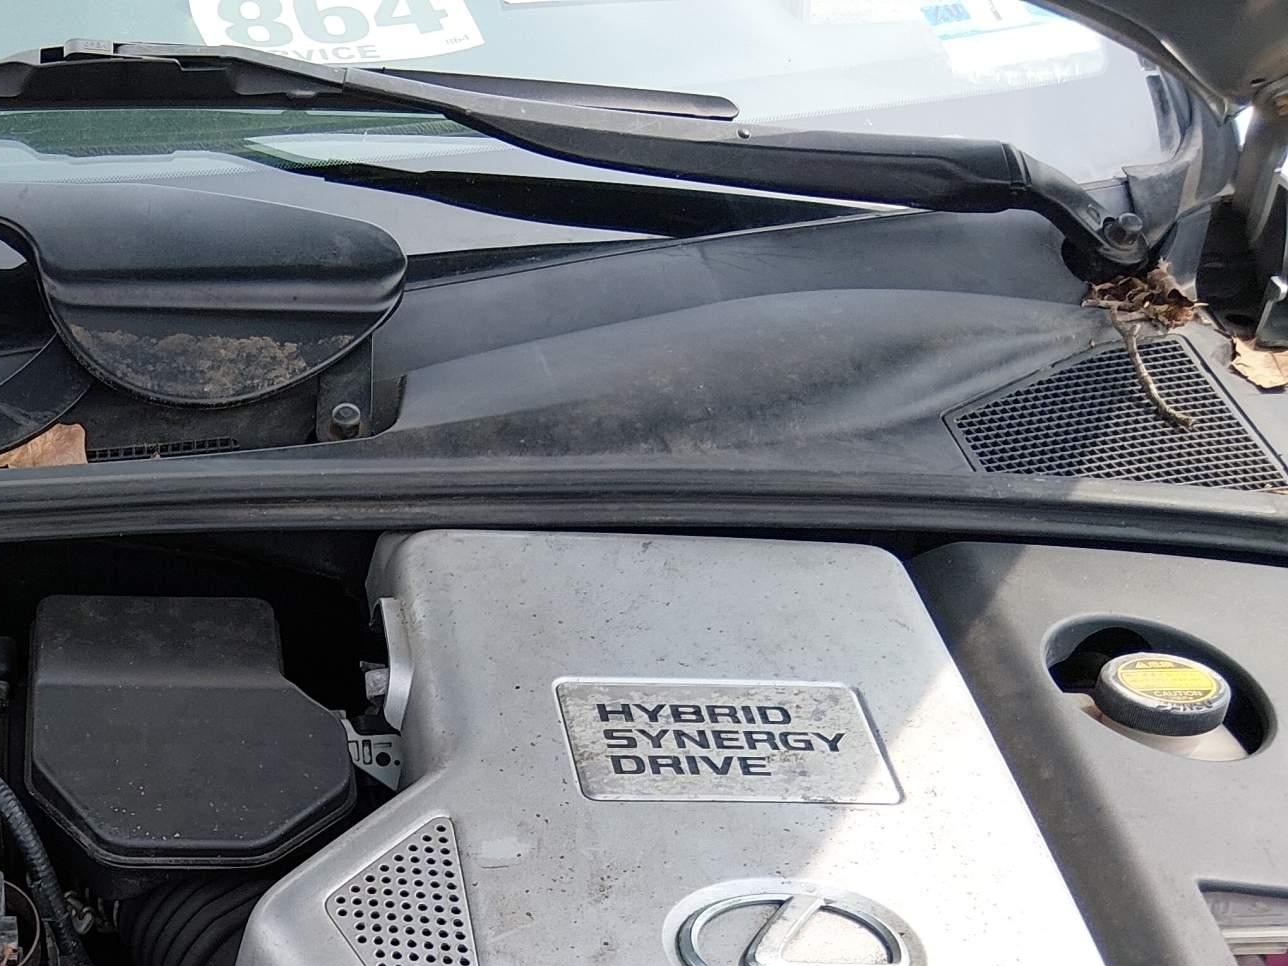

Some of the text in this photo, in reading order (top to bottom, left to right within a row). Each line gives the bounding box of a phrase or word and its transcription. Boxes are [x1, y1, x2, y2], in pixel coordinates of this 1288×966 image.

[216, 0, 448, 47] 864
[596, 703, 792, 725] HYBRID
[603, 728, 846, 753] SYNERGY
[605, 755, 772, 776] DRIVE
